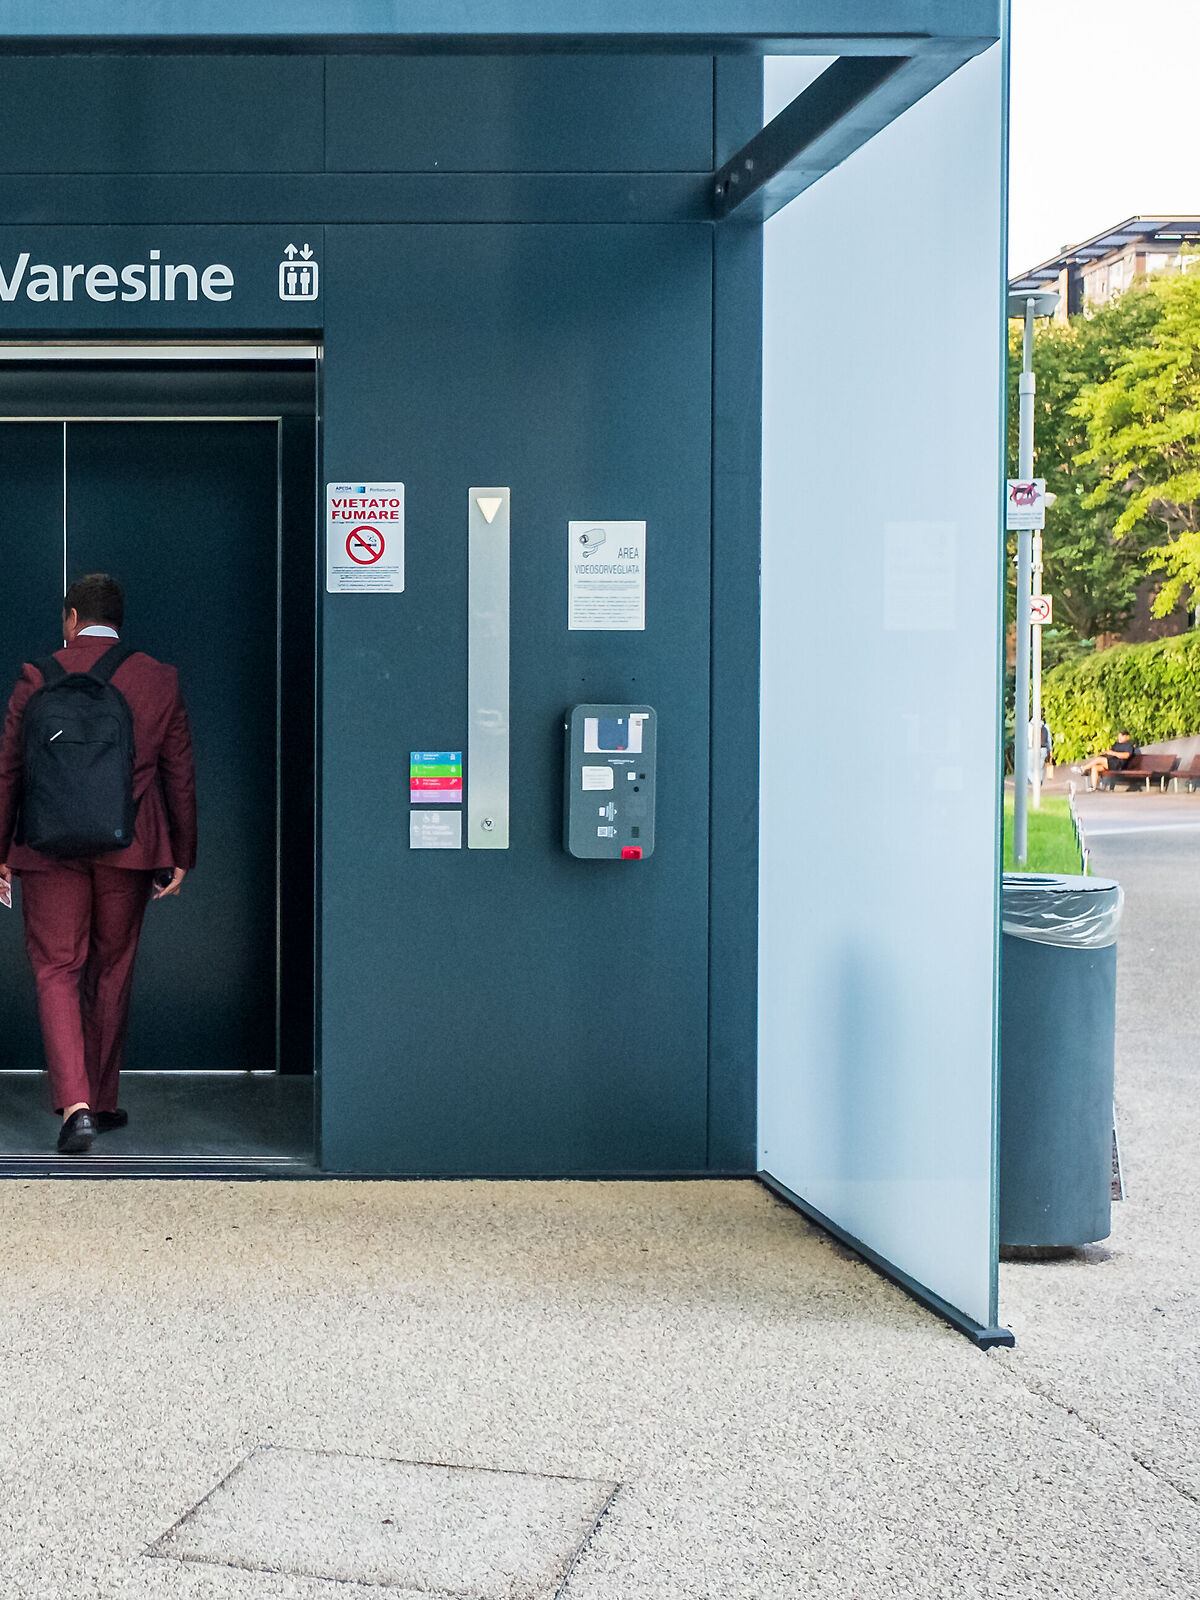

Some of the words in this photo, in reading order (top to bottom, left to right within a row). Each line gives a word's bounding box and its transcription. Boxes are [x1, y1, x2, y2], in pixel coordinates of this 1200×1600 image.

[331, 498, 400, 508] VIETATO
[331, 510, 399, 520] FUMARE
[617, 547, 640, 559] AREA
[574, 564, 640, 575] VIDEOSORVEGLIATA
